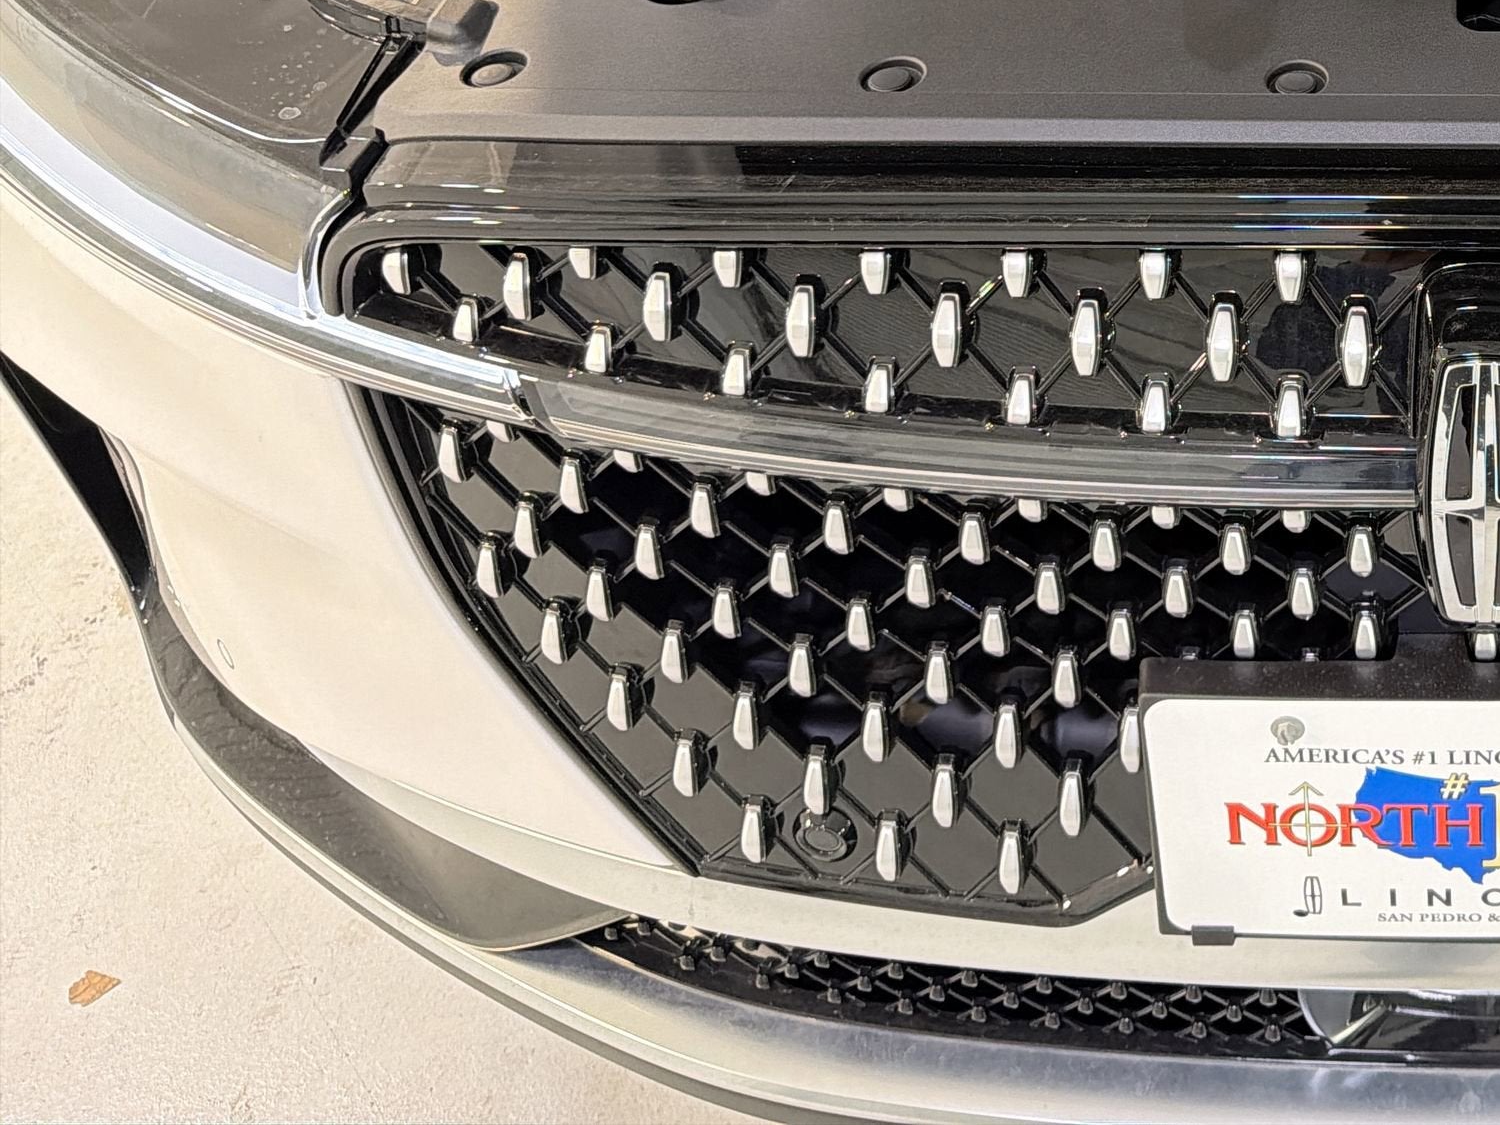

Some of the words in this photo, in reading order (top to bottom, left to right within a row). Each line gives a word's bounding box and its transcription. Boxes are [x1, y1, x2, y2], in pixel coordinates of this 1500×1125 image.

[1412, 750, 1439, 765] #1
[1223, 801, 1485, 848] NORTH
[1377, 912, 1418, 923] SAN
[1419, 912, 1482, 923] PEDRO
